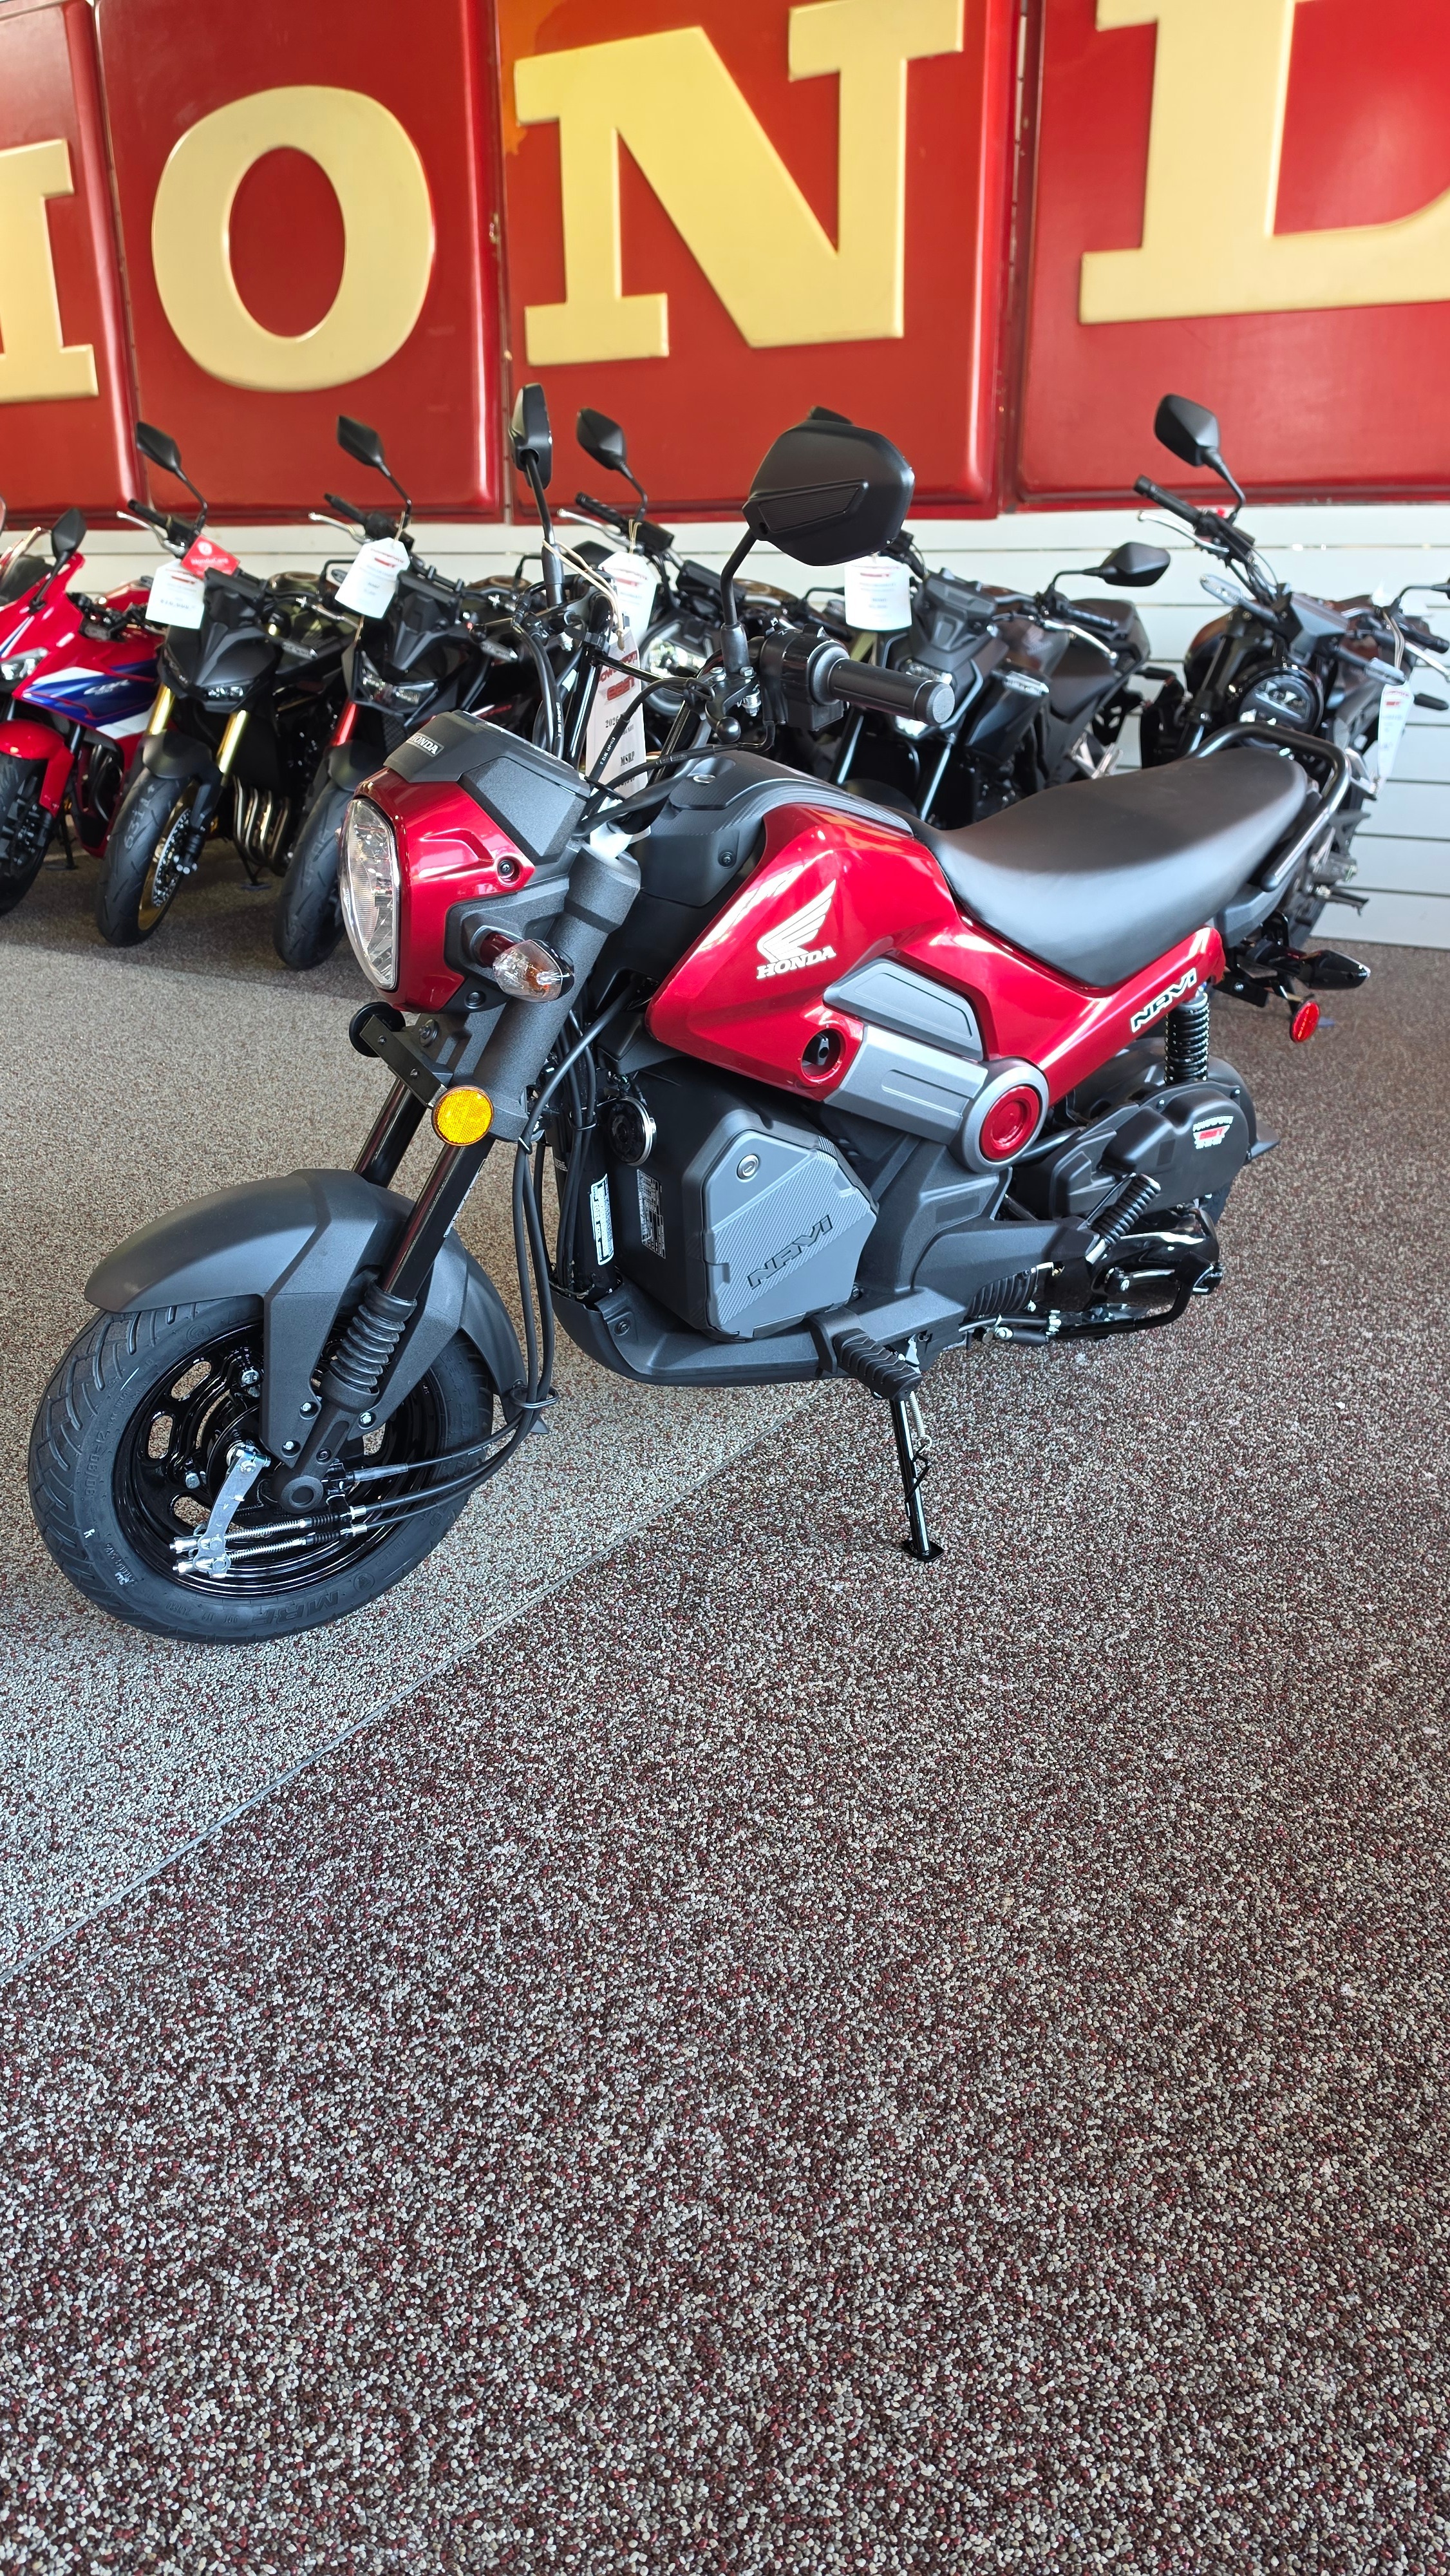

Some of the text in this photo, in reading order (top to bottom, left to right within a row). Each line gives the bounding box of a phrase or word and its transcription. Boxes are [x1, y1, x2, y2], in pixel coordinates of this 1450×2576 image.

[410, 735, 438, 755] HONDA
[620, 750, 635, 766] MSRP
[757, 945, 837, 980] HONDA
[1131, 967, 1197, 1032] NAVI
[748, 1215, 833, 1290] NAVI
[251, 1591, 339, 1625] MRF
